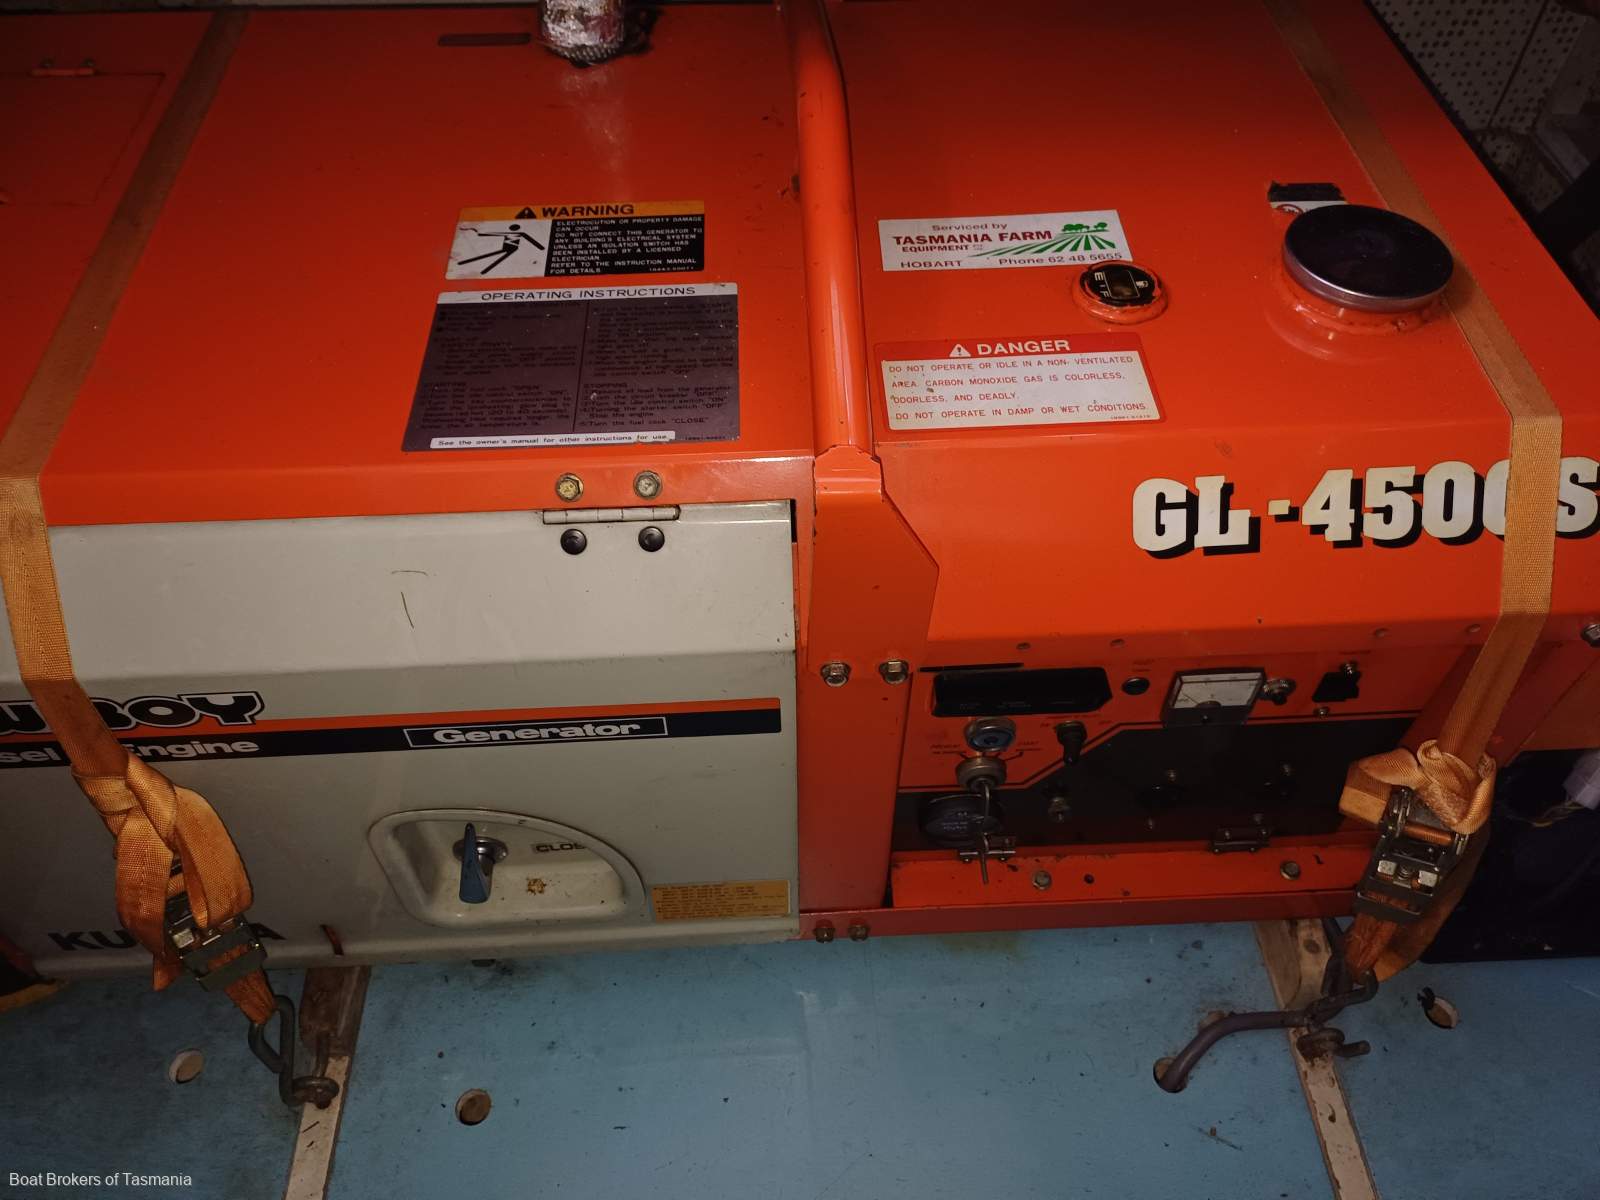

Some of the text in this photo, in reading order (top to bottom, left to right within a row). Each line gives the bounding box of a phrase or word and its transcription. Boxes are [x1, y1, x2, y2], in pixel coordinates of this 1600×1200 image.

[542, 204, 634, 217] WARNING
[932, 221, 1008, 232] Serviced by
[893, 230, 1053, 246] TASMANIA FARM
[901, 243, 970, 253] EQUIPMENT
[899, 260, 963, 269] HOBART
[998, 252, 1123, 266] Phone 62 48 5655
[481, 286, 696, 301] OPERATING INSTRUCTIONS
[976, 339, 1071, 356] DANGER
[888, 365, 902, 373] DO
[906, 364, 925, 373] NOT
[930, 363, 973, 372] OPERATE
[979, 361, 992, 369] OR
[996, 360, 1018, 369] IDLE
[1022, 359, 1032, 367] IN
[1036, 359, 1044, 367] A
[1074, 356, 1134, 366] VENTILATED
[925, 379, 964, 387] CARBON
[969, 377, 1017, 385] MONOXIDE
[1023, 375, 1043, 383] GAS
[1049, 374, 1059, 382] IS
[954, 393, 973, 401] AND
[895, 412, 909, 420] DO
[915, 411, 934, 419] NOT
[940, 409, 986, 419] OPERATE
[992, 408, 1002, 416] IN
[1007, 407, 1034, 416] DAMP
[1040, 406, 1054, 415] OR
[1060, 405, 1080, 413] WET
[433, 722, 641, 745] Generator
[126, 740, 260, 759] ngine
